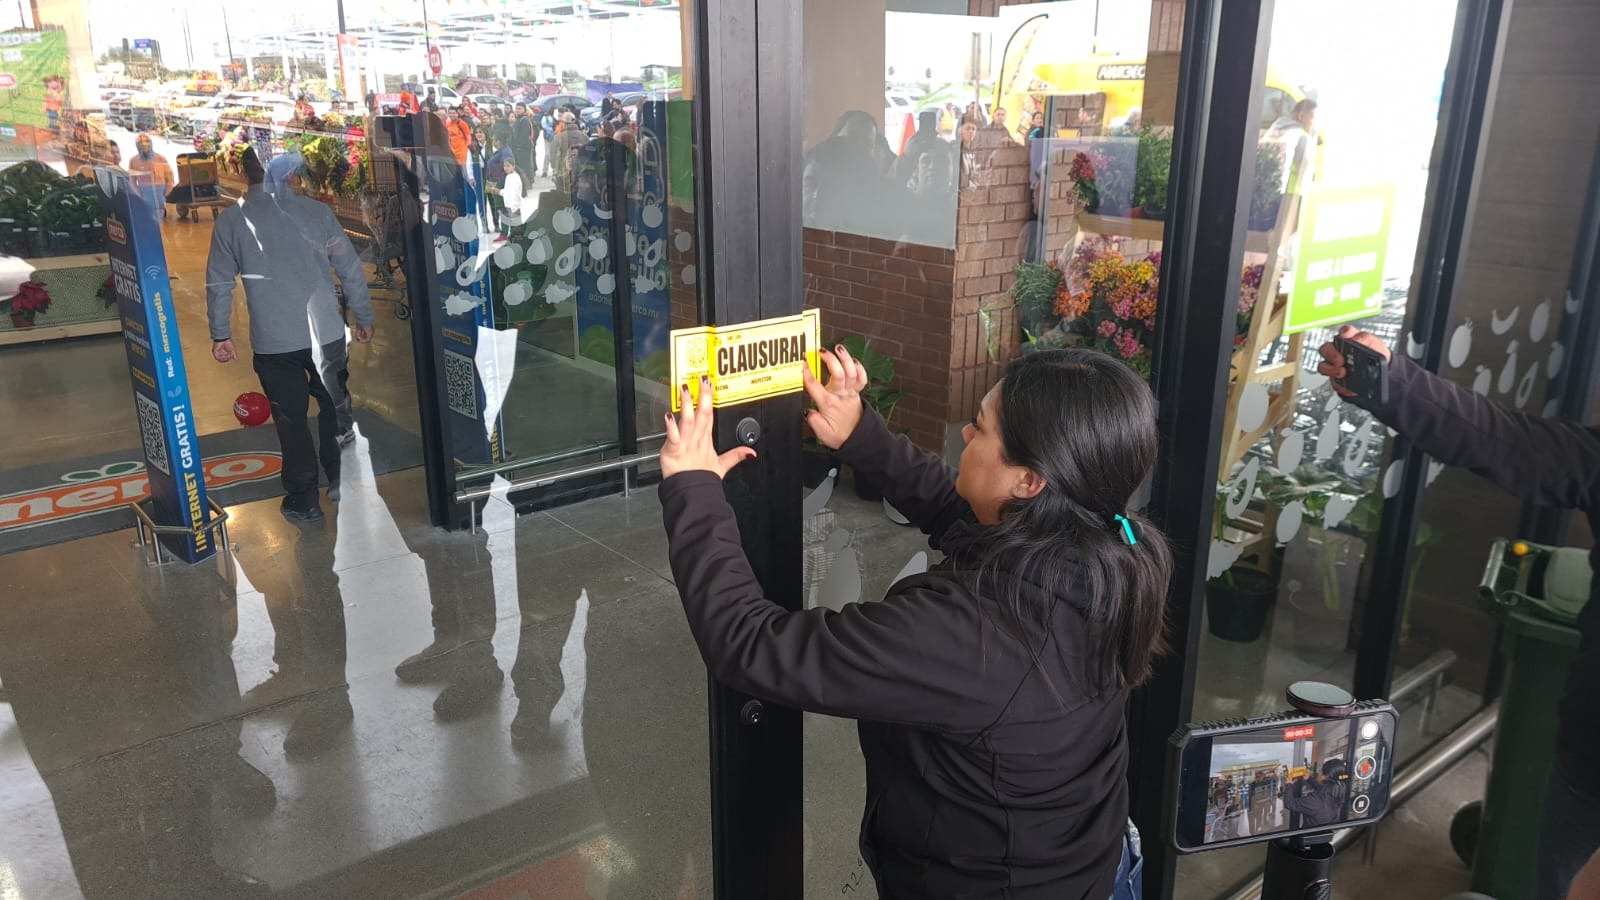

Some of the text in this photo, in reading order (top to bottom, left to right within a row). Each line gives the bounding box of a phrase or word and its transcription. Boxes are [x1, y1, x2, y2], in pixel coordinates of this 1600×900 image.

[114, 275, 142, 304] GRATIS
[153, 292, 175, 378] Red: mercogratis
[172, 404, 193, 469] GRATIS!
[0, 459, 265, 521] mero
